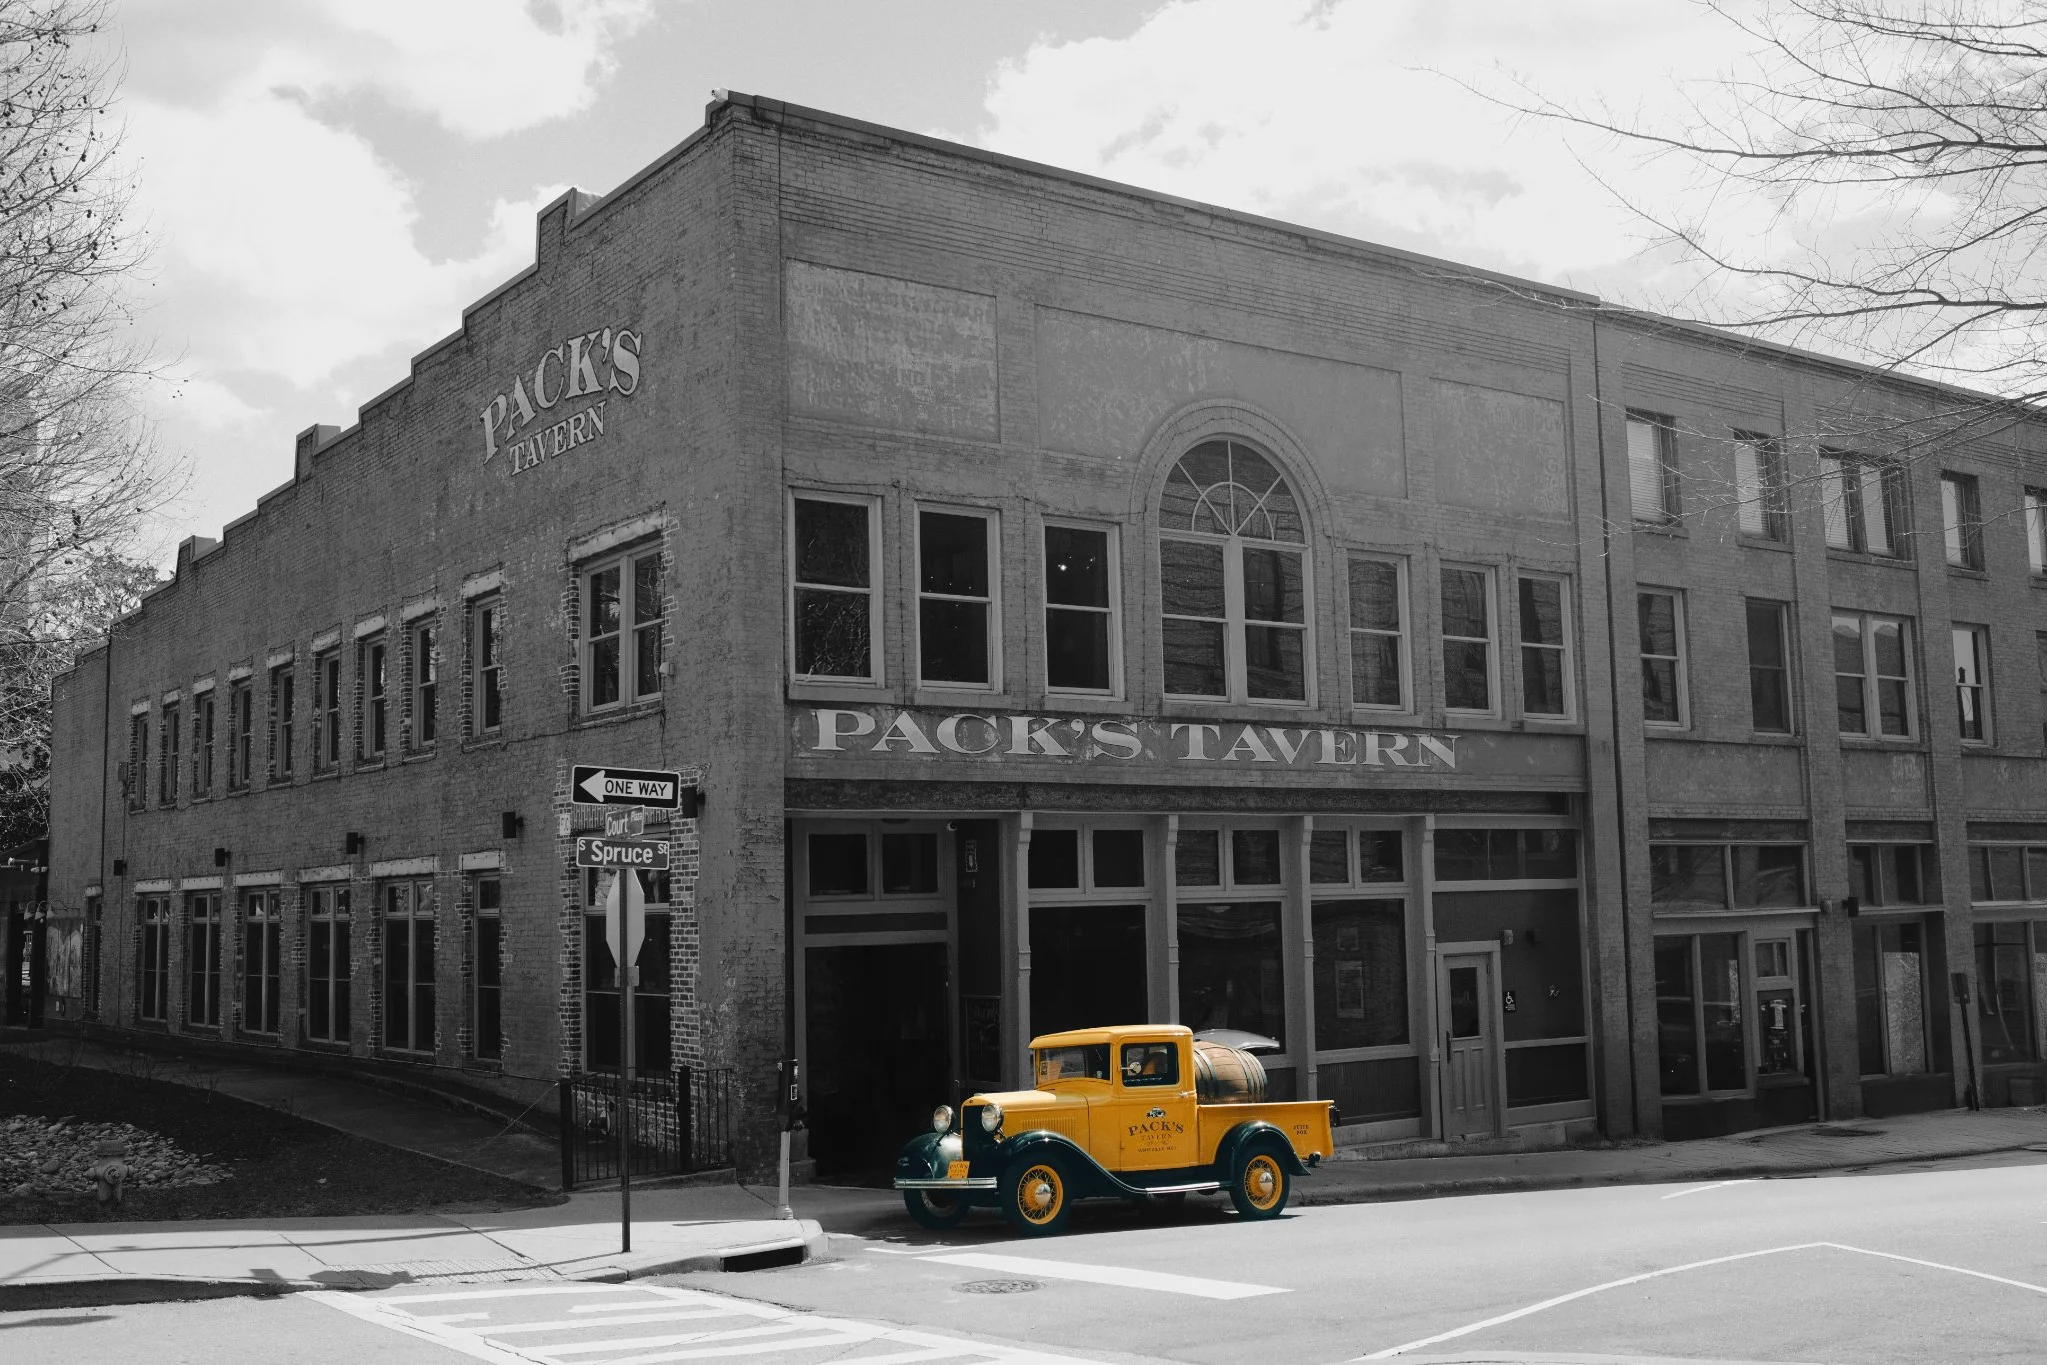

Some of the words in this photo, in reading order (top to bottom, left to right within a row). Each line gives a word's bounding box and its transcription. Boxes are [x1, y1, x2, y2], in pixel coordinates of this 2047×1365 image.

[480, 326, 642, 465] PACK'S
[509, 401, 607, 477] TAVERN
[811, 709, 1142, 759] PACK'S
[1171, 723, 1461, 769] TAVERN
[605, 780, 633, 795] ONE
[638, 781, 668, 797] WAY
[606, 812, 629, 837] Court
[579, 839, 586, 851] S
[591, 840, 654, 866] Spruce
[657, 843, 668, 855] St
[1128, 1121, 1185, 1137] PACK'S
[1140, 1133, 1173, 1141] TAVERN
